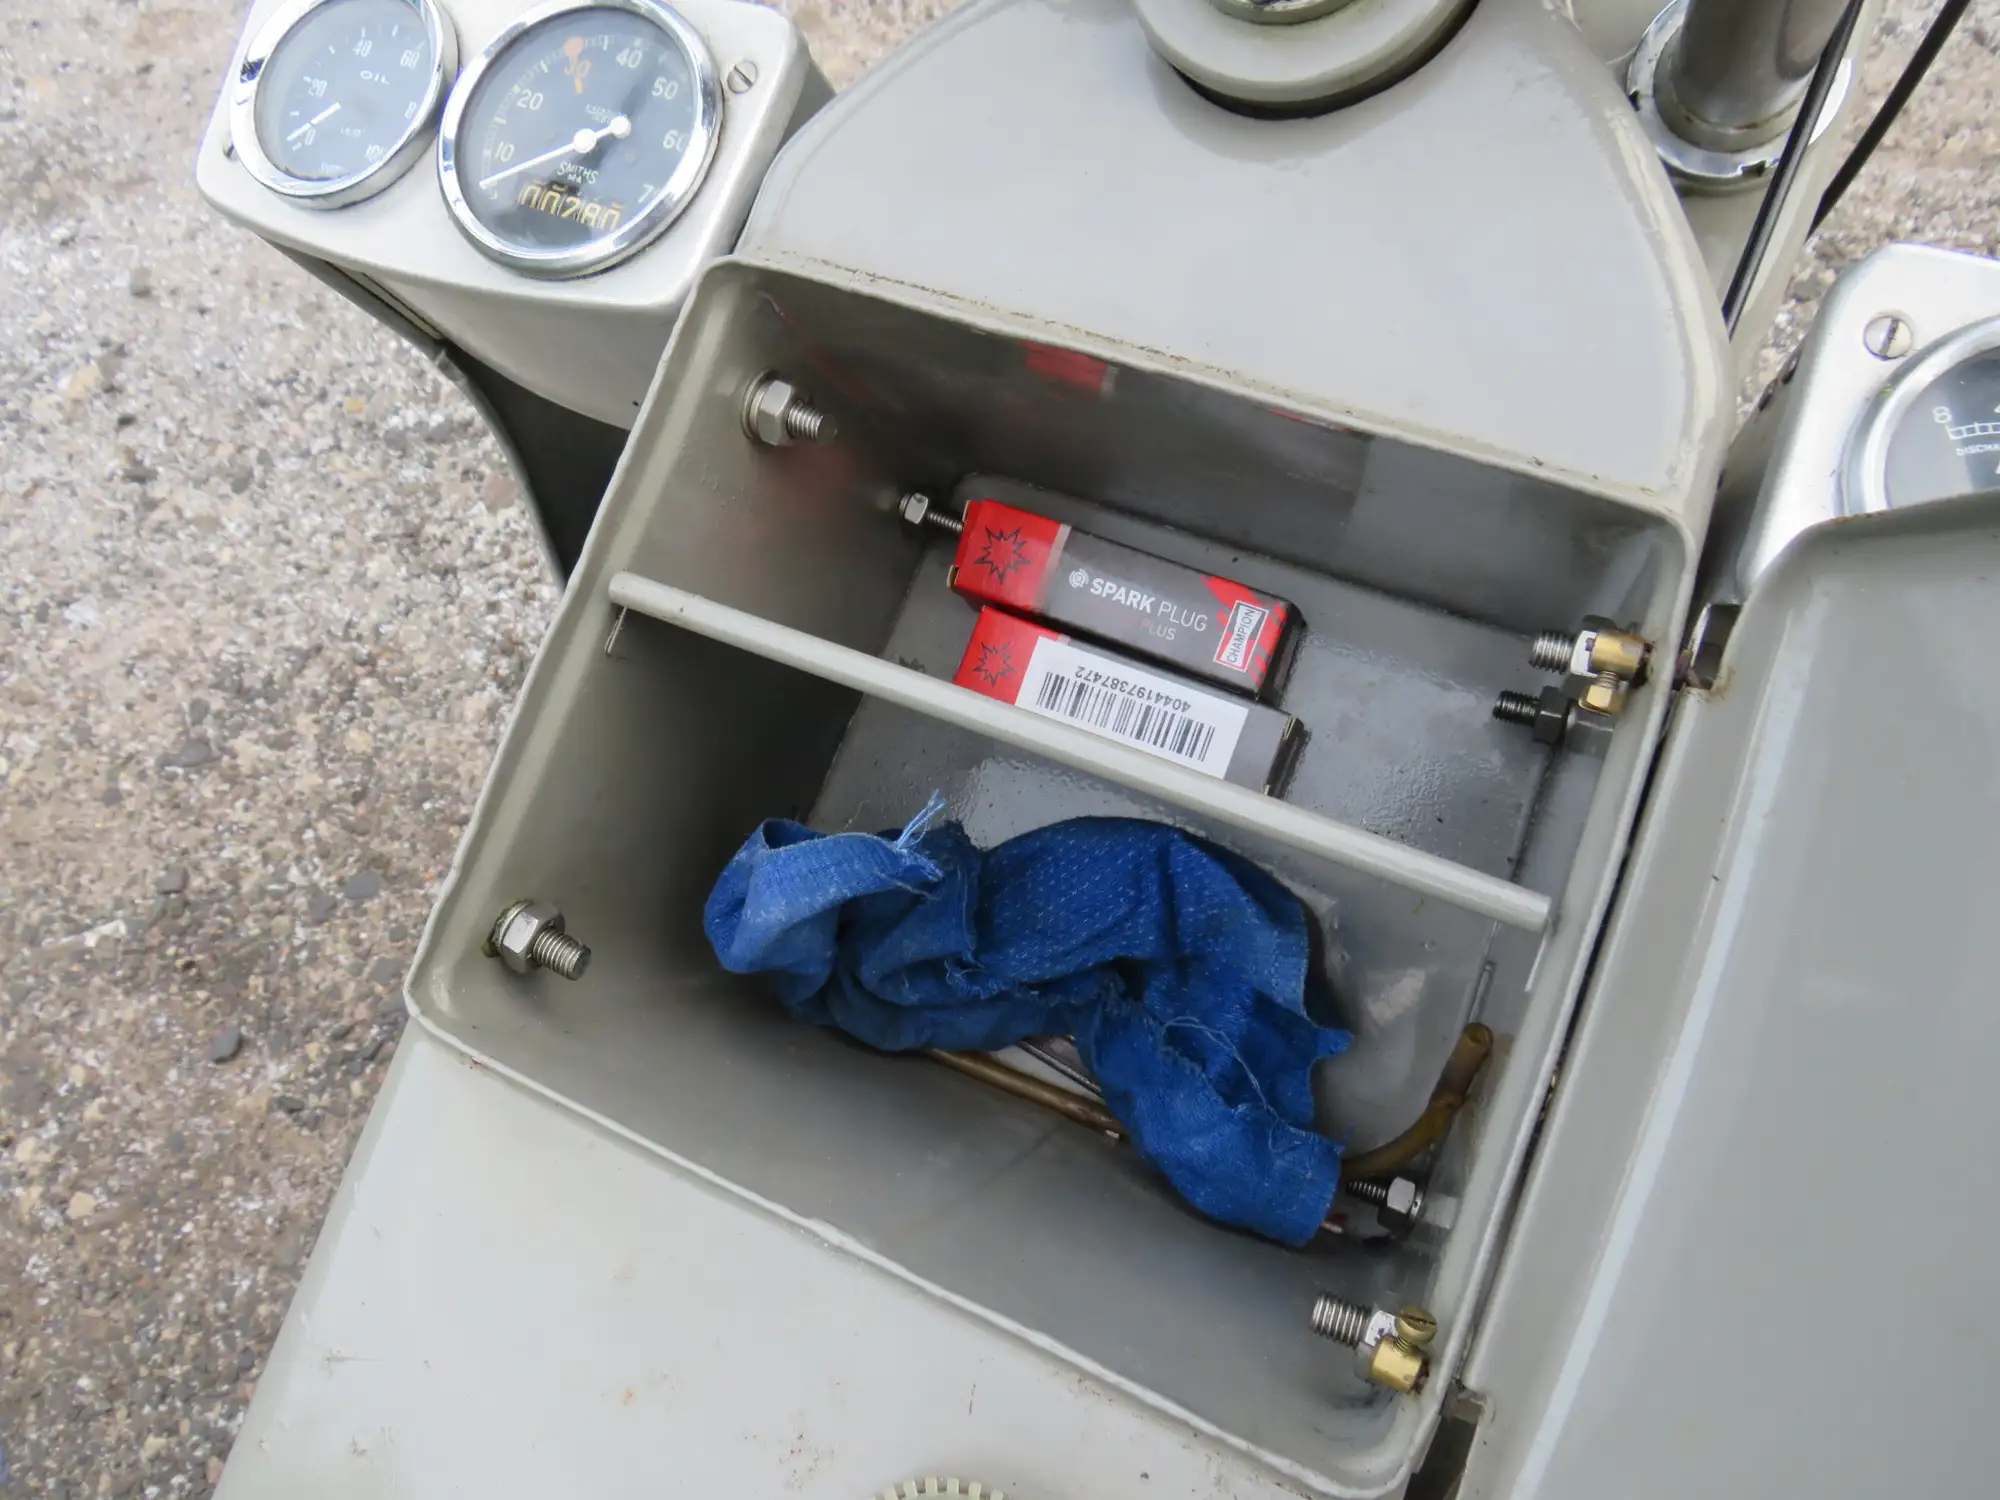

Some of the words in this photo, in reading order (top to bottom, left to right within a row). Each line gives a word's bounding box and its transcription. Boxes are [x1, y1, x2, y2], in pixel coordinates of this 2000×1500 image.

[353, 40, 372, 58] 40
[400, 49, 420, 68] 60
[616, 48, 642, 69] 40
[308, 78, 327, 97] 20
[360, 70, 390, 85] OIL
[652, 76, 678, 99] 50
[517, 89, 544, 110] 20
[496, 141, 514, 162] 10
[557, 161, 599, 185] SMITHS
[1932, 406, 1952, 424] 8
[1090, 578, 1156, 613] SPARK
[1157, 601, 1208, 632] PLUG
[1140, 618, 1177, 640] PLUS
[1226, 608, 1256, 663] CHAMPION
[1075, 665, 1191, 713] 4044197387472
